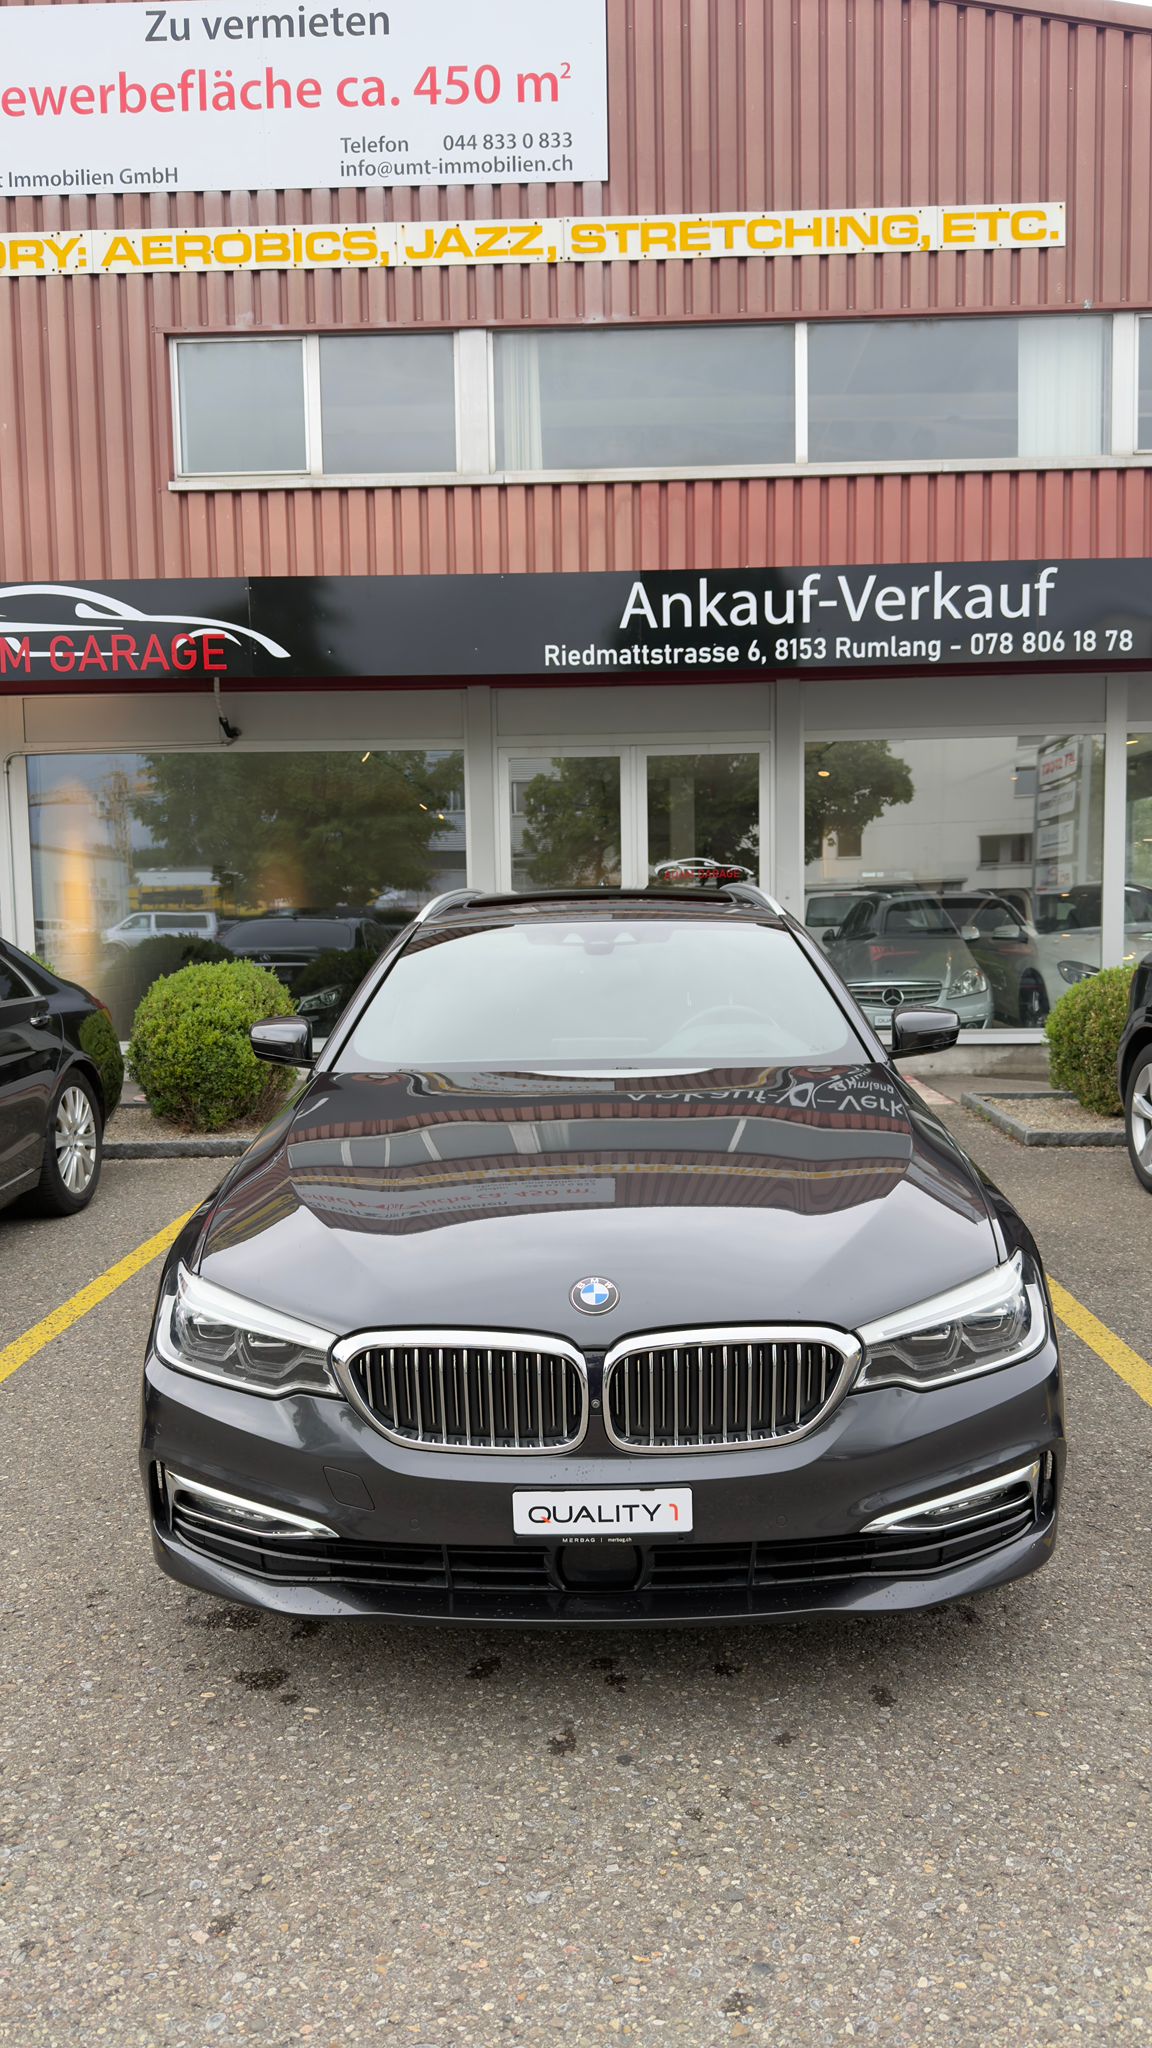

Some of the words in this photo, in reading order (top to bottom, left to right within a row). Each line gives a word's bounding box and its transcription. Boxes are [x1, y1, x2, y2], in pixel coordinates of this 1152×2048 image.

[144, 10, 191, 42] Zu
[201, 5, 390, 40] vermieten
[336, 77, 401, 108] ca.
[413, 64, 501, 106] 450
[340, 135, 409, 154] Telefon
[443, 134, 478, 151] 044
[482, 133, 517, 150] 833
[522, 133, 534, 149] 0
[538, 131, 573, 149] 833
[8, 168, 114, 188] Immobilien
[119, 166, 178, 185] GmbH
[340, 154, 573, 178] info@umt-immobilien.ch
[0, 237, 87, 271] RY:
[101, 229, 390, 269] AEROBICS,
[405, 224, 557, 264] JAZZ,
[571, 214, 931, 254] STRETCHING,
[943, 210, 1060, 244] ETC.
[619, 566, 1059, 630] Ankauf-Verkauf
[49, 633, 229, 673] GARAGE
[544, 643, 740, 667] Riedmattstrasse
[747, 639, 767, 665] 6,
[775, 637, 827, 661] 8153
[835, 634, 941, 662] Rumlang
[970, 632, 1014, 655] 078
[1022, 631, 1065, 654] 806
[1073, 629, 1097, 652] 18
[1105, 629, 1133, 652] 78
[528, 1503, 662, 1524] QUALITY
